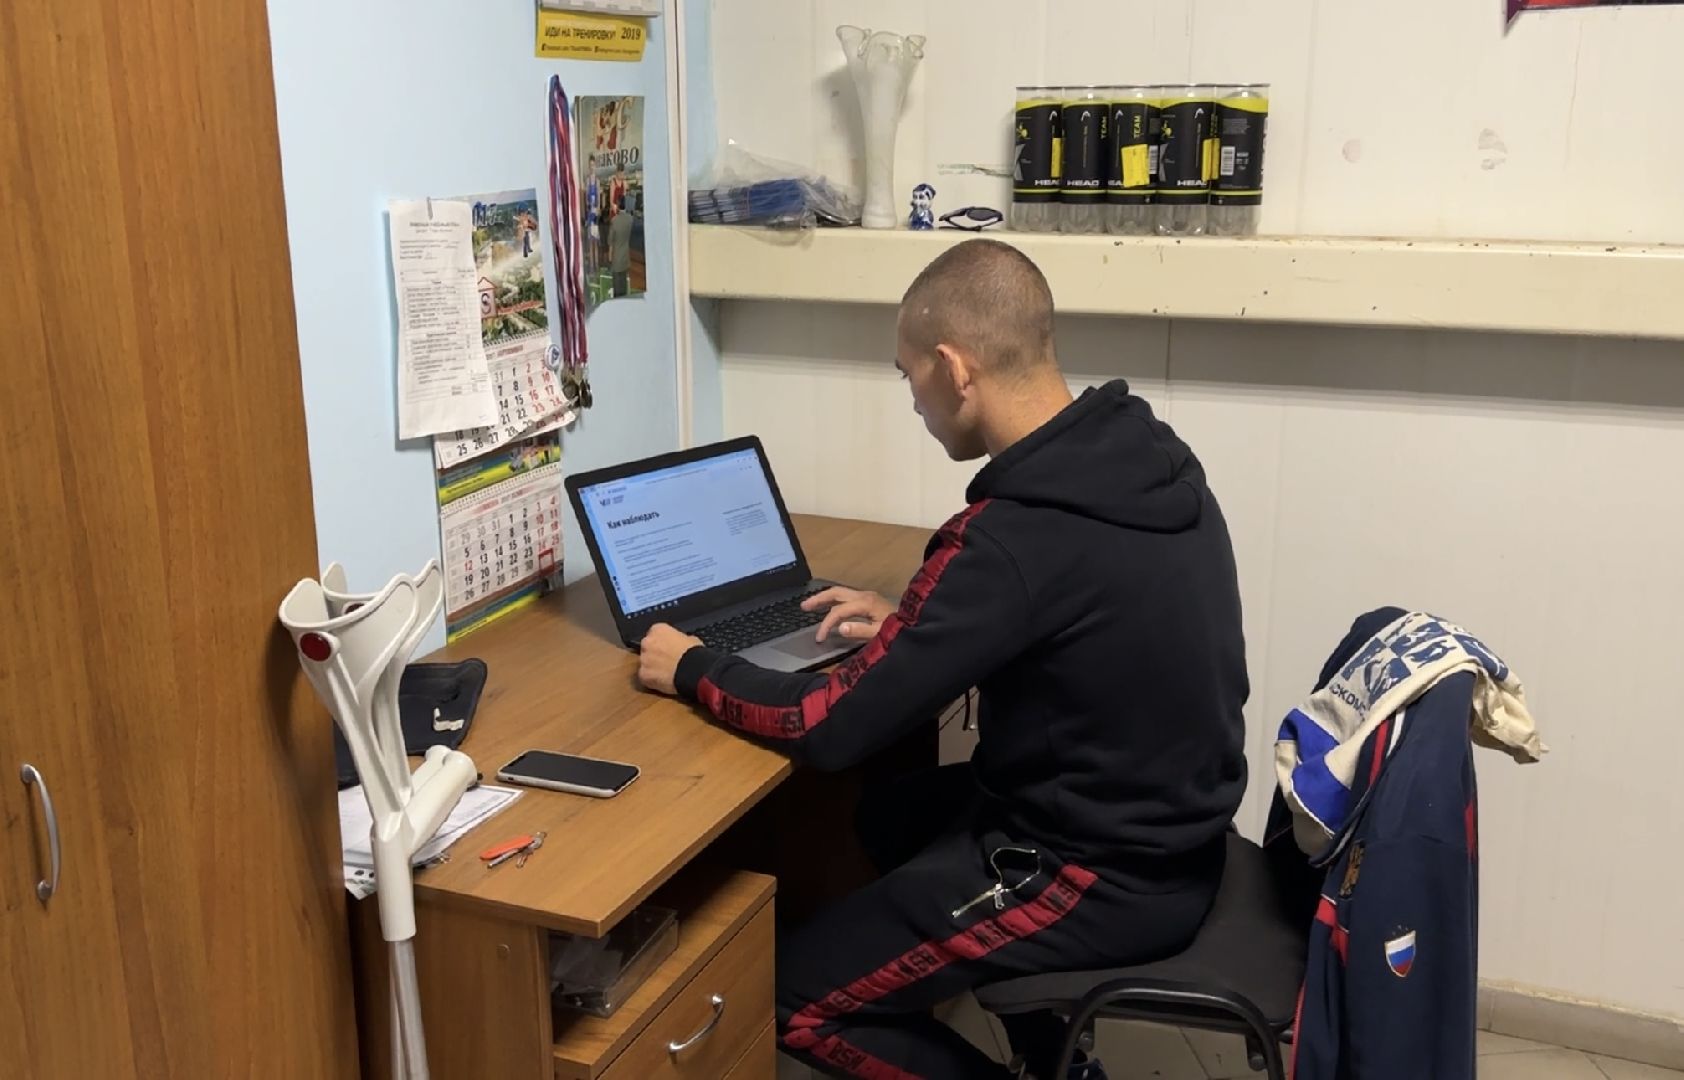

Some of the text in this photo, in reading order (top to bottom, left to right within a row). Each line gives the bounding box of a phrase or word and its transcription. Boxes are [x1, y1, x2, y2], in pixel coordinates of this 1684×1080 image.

[561, 28, 571, 37] НА
[621, 27, 641, 40] 2019
[1133, 114, 1142, 139] TEAM
[513, 380, 519, 391] 8
[499, 385, 554, 411] 14 15 16 17
[501, 412, 511, 425] 21
[516, 408, 527, 420] 22
[532, 402, 545, 413] 23
[457, 442, 468, 456] 25
[473, 437, 484, 450] 26
[488, 431, 499, 444] 27
[522, 507, 528, 518] 2
[606, 511, 660, 529] Как наблюдать
[464, 547, 470, 558] 5
[480, 540, 486, 551] 6
[495, 533, 500, 545] 7
[523, 520, 528, 531] 9
[550, 508, 558, 519] 11
[464, 559, 473, 571] 12
[480, 553, 488, 565] 13
[494, 545, 504, 558] 14
[509, 539, 518, 551] 15
[523, 533, 532, 545] 16
[464, 574, 474, 586] 19
[480, 566, 490, 580] 20
[496, 559, 504, 573] 21
[509, 552, 518, 566] 22
[524, 546, 533, 559] 23
[464, 589, 475, 601] 26
[481, 579, 490, 593] 27
